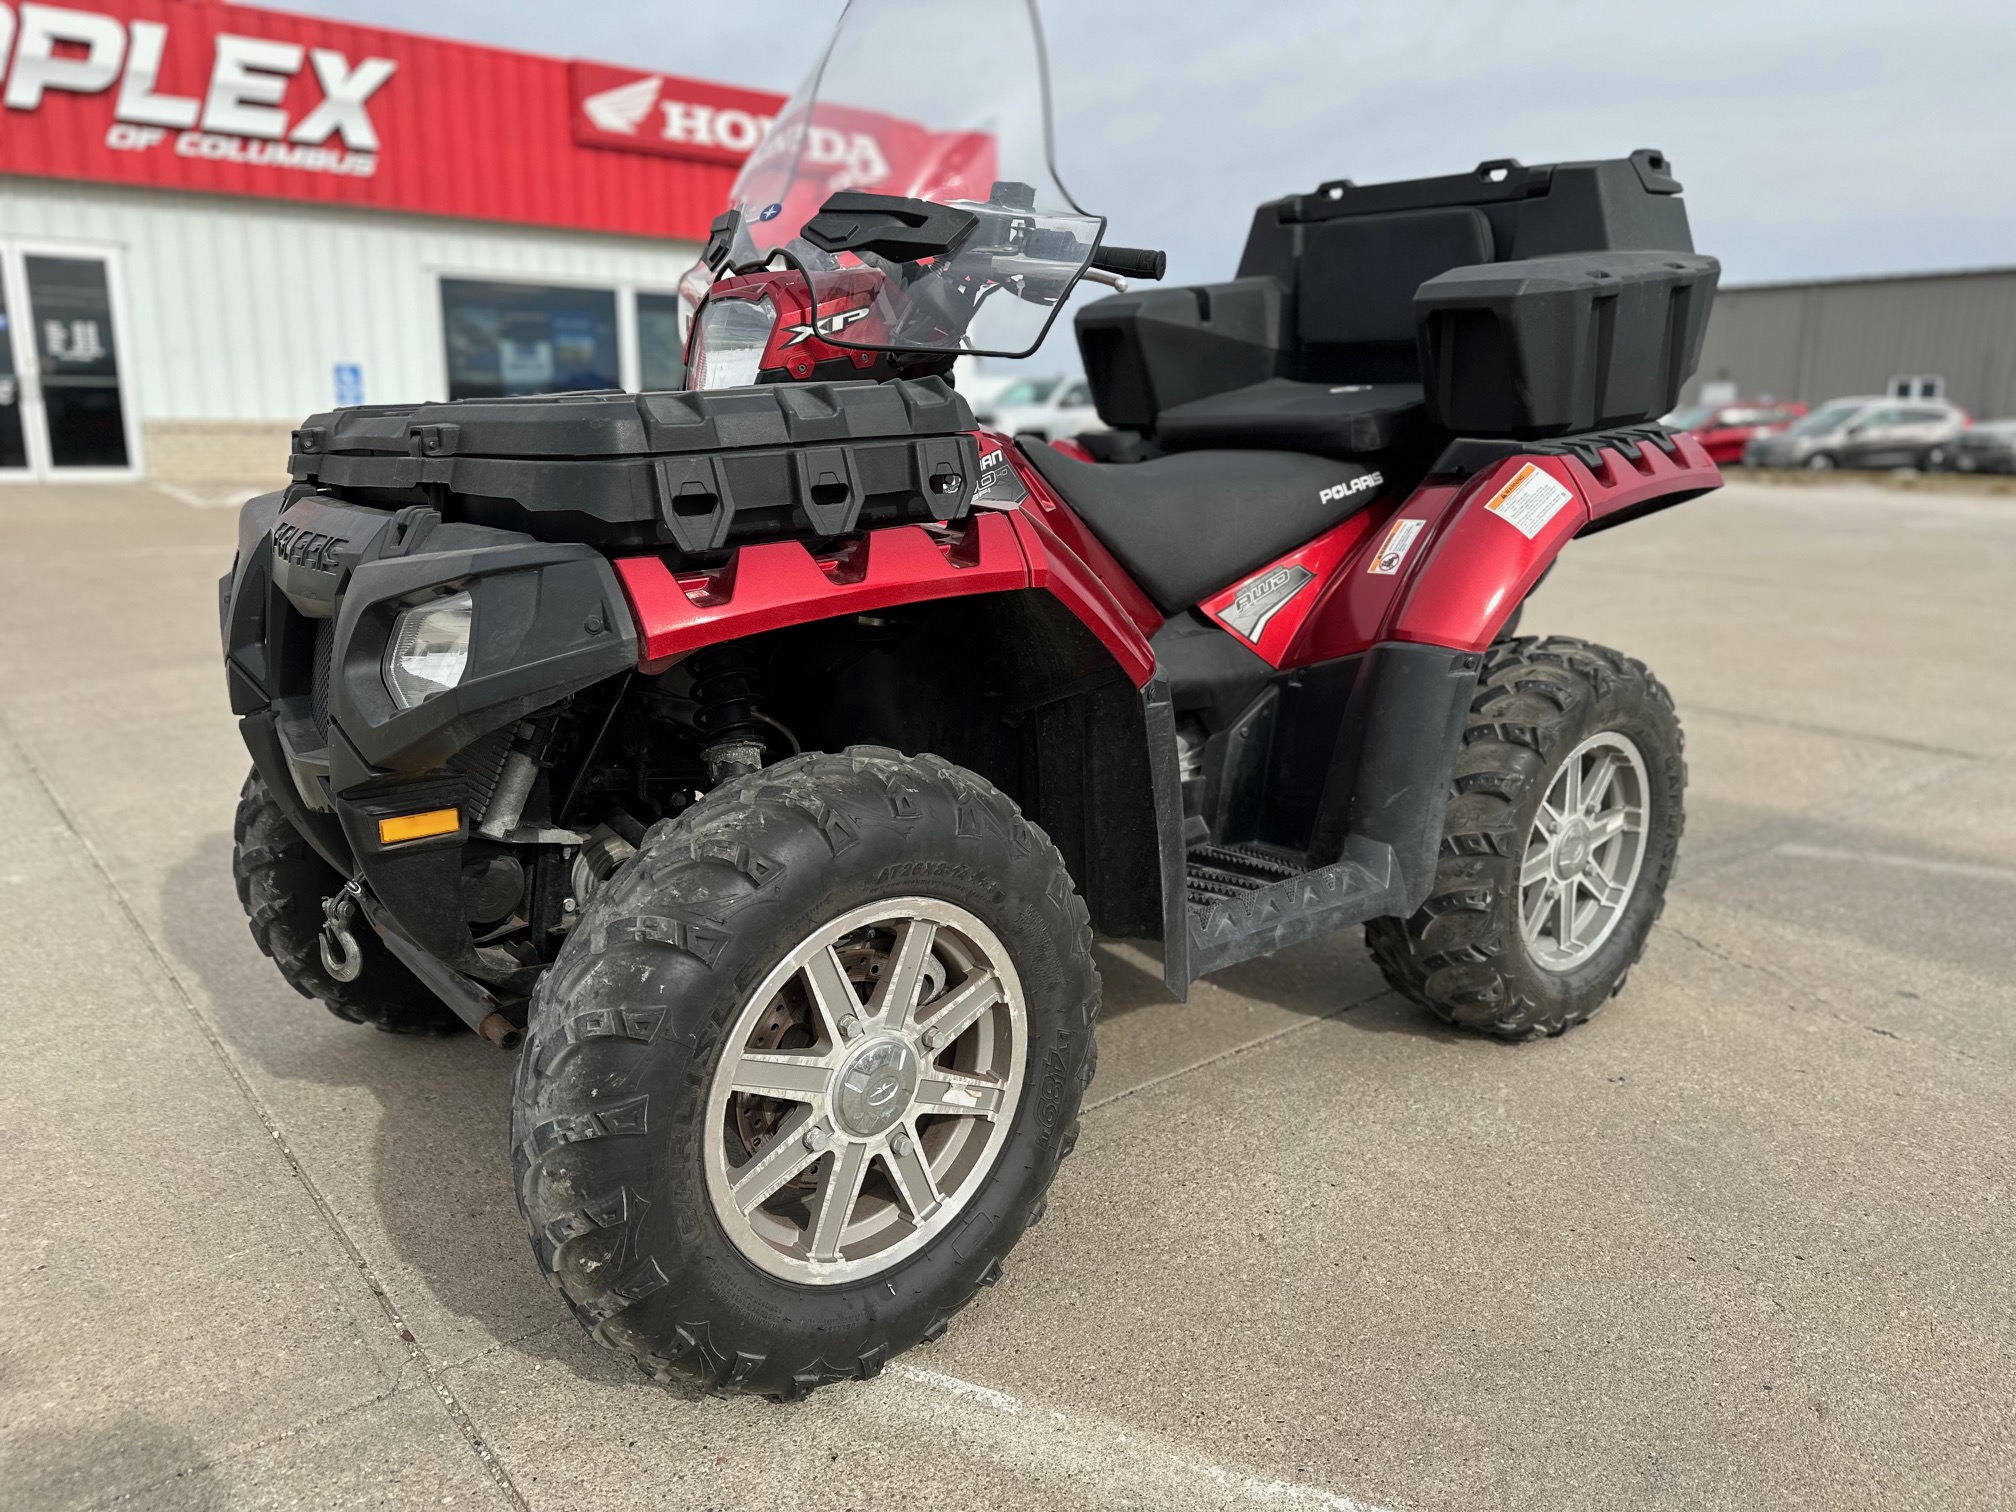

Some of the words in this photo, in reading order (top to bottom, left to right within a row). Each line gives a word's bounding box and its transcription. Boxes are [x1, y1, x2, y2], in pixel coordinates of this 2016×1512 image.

[0, 3, 398, 152] PLEX
[105, 123, 168, 152] OF
[174, 130, 377, 178] COLUMBUS
[778, 306, 870, 350] XP
[1319, 471, 1384, 505] POLARIS
[1234, 568, 1291, 613] AWD
[1035, 1046, 1067, 1129] 489
